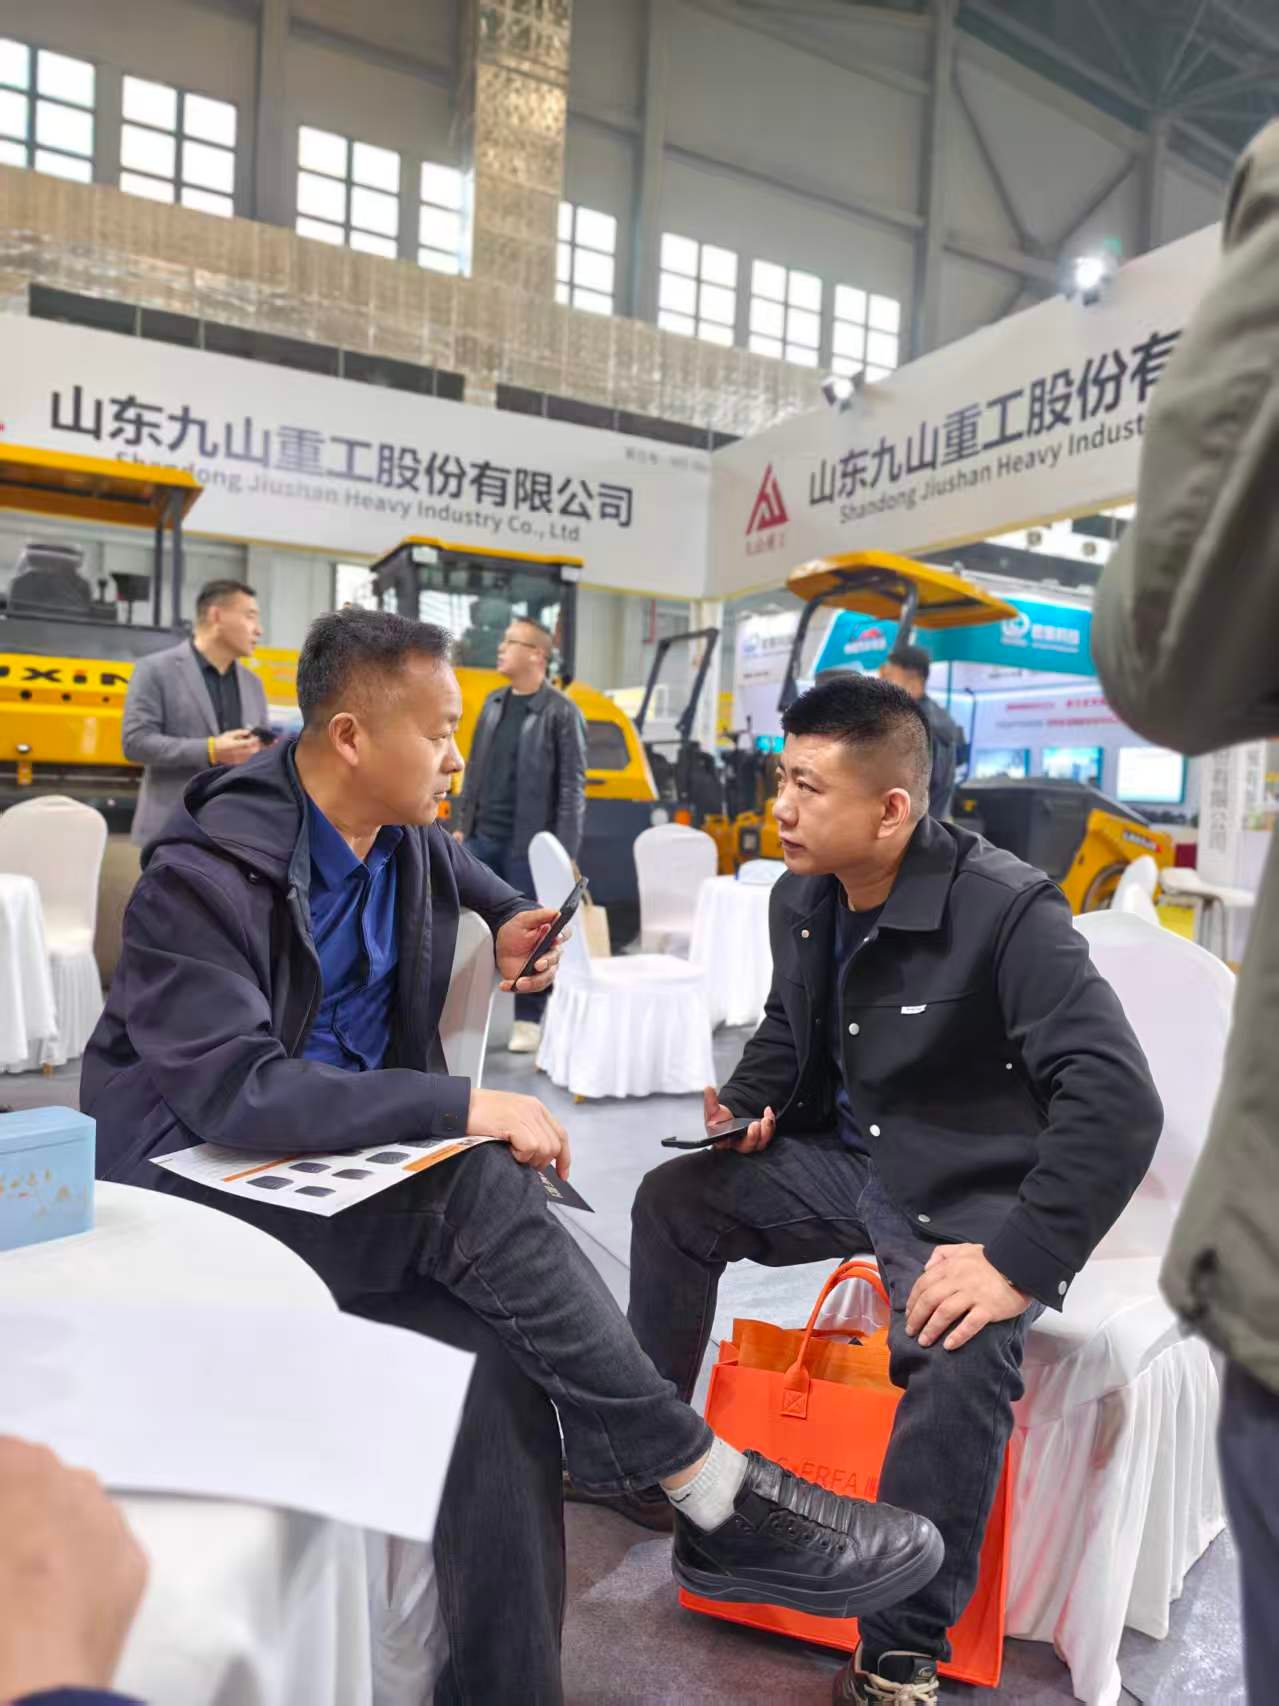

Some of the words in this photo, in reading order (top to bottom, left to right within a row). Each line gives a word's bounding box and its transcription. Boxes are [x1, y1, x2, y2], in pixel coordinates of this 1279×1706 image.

[50, 384, 634, 528] 山东九山重工股份有限公司
[839, 486, 917, 525] Shandong
[920, 463, 992, 501] Jiushan
[997, 442, 1063, 478] Heavy
[248, 473, 338, 503] Jiushan
[345, 488, 412, 520] Heavy
[417, 500, 503, 533] Industry
[507, 514, 546, 542] Co.,
[549, 524, 581, 542] Ltd
